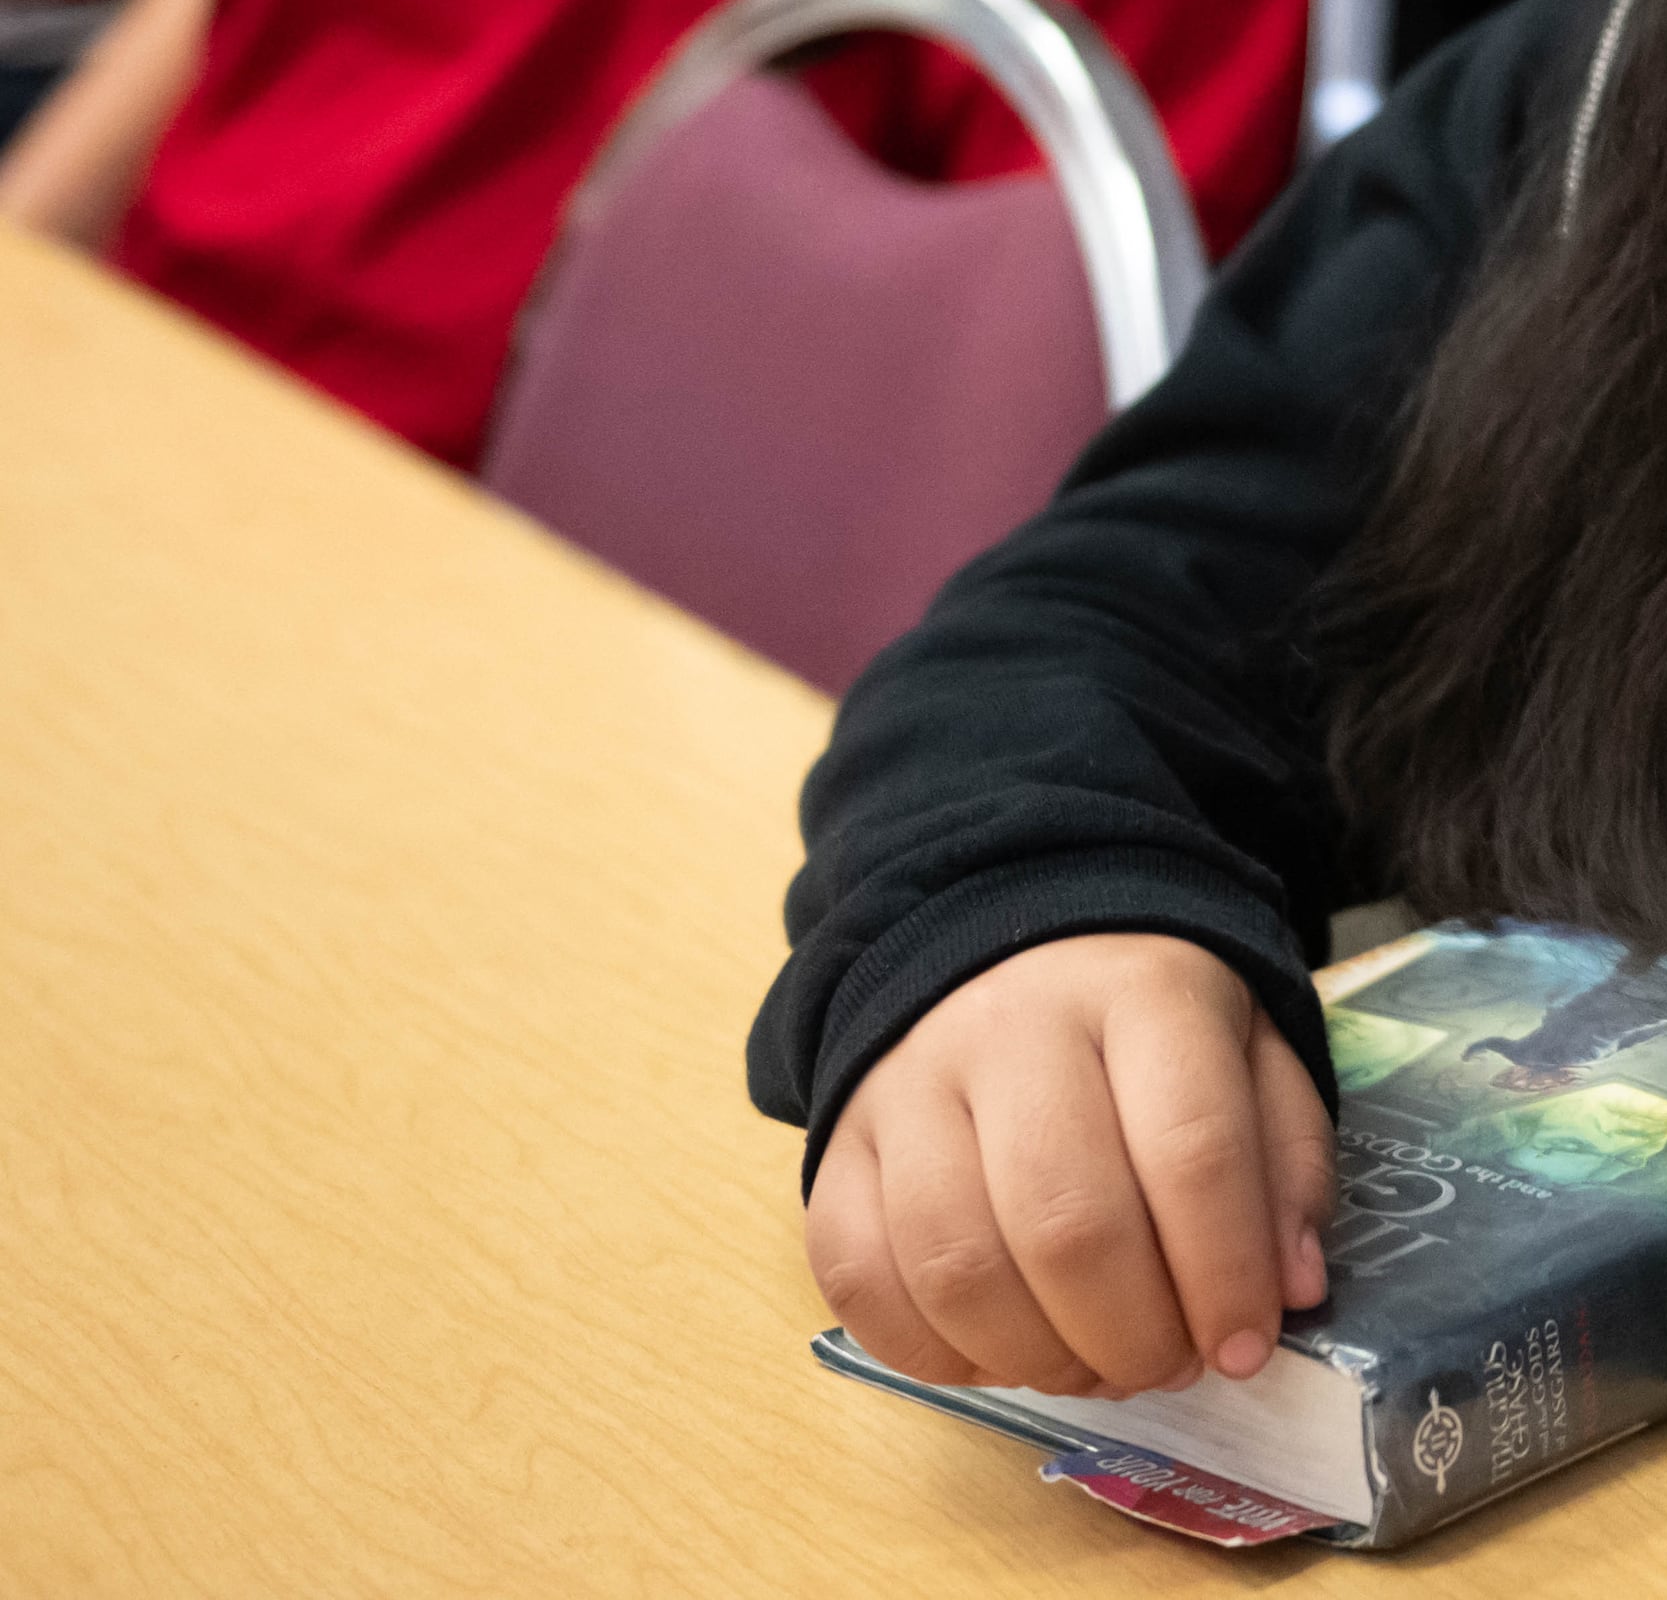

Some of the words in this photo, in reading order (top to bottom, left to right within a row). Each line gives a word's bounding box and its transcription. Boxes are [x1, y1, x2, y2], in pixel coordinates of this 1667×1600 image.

[1341, 1131, 1463, 1172] GODS
[1465, 1164, 1505, 1184] the
[1498, 1179, 1553, 1199] and
[1525, 1326, 1546, 1404] GODS
[1544, 1318, 1568, 1427] ASGARD
[1506, 1349, 1530, 1460] CHASE
[1096, 1454, 1190, 1493] YOUR
[1204, 1496, 1298, 1531] VOTE
